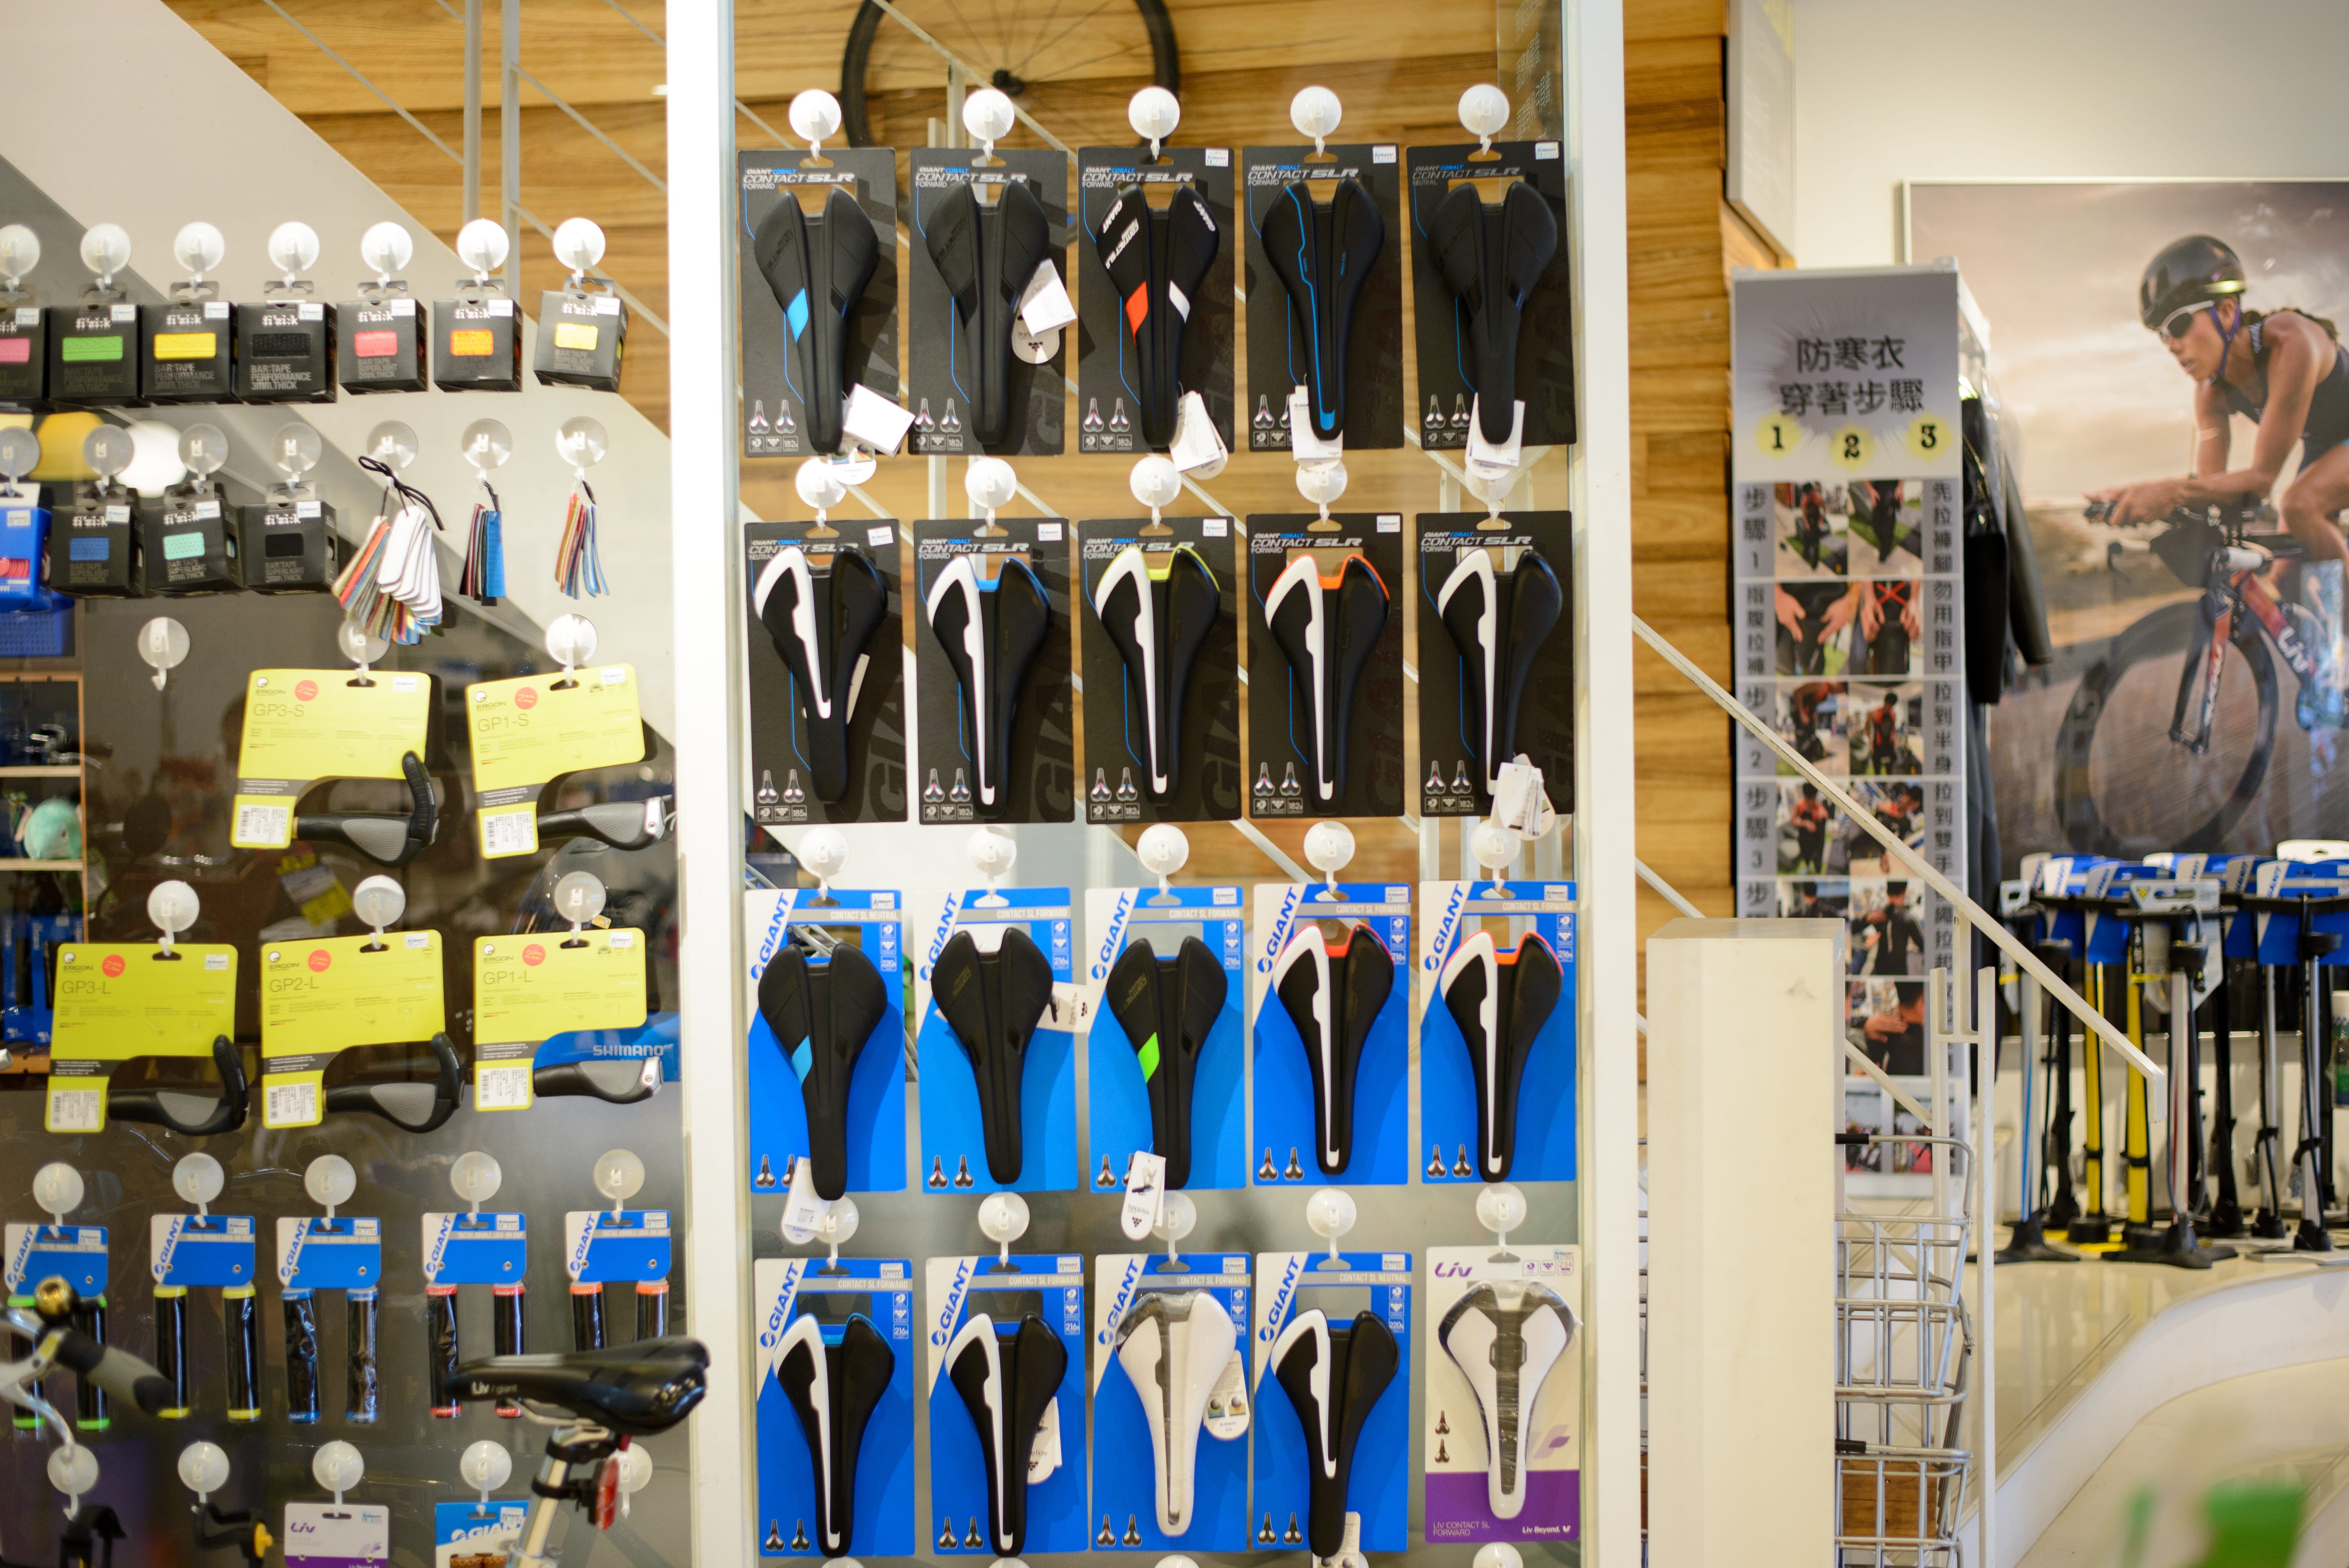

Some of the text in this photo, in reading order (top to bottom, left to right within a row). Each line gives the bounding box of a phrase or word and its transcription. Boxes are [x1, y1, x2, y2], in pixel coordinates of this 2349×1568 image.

[743, 174, 855, 183] CONTACT SLR
[916, 173, 978, 182] CONTACT
[1082, 173, 1193, 182] CONTACT SLR
[1248, 168, 1358, 180] CONTACT SLR
[1413, 167, 1520, 180] CONTACT SLR
[1102, 199, 1122, 233] GIANT
[1193, 200, 1215, 231] GIANT
[1796, 335, 1905, 372] 防寒衣
[251, 372, 312, 381] PERFORMANCE
[1780, 378, 1924, 416] 穿著步驟
[1773, 426, 1784, 449] 1
[1921, 425, 1937, 449] 3
[1844, 435, 1860, 459] 2
[919, 543, 1029, 553] CONTACT SLR
[1251, 538, 1362, 547] CONTACT SLR
[1421, 536, 1532, 546] CONTACT SLR
[2278, 626, 2310, 673] Liv
[254, 704, 305, 717] GP3-S
[478, 714, 529, 731] GP1-S
[997, 908, 1067, 919] CONTACT SL FORWARD
[1169, 909, 1239, 919] CONTACT SL FORWARD
[1336, 905, 1406, 914] CONTACT SL FORWARD
[1502, 902, 1573, 911] CONTACT SL FORWARD
[831, 911, 898, 920] CONTACT SL NEUTRAL
[1267, 887, 1297, 956] GIANT
[1434, 884, 1463, 954] GIANT
[760, 892, 789, 963] GIANT
[929, 893, 957, 963] GIANT
[1101, 892, 1130, 963] GIANT
[270, 976, 319, 992] GP2-L
[484, 970, 533, 985] GP1-L
[62, 981, 111, 994] GP3-L
[593, 1045, 664, 1056] SHIMANO
[160, 1217, 180, 1263] GIANT
[286, 1219, 305, 1266] GIANT
[432, 1215, 451, 1262] GIANT
[576, 1213, 595, 1260] GIANT
[14, 1226, 34, 1272] GIANT
[1435, 1262, 1473, 1277] Liv
[839, 1280, 908, 1288] CONTACT SL FORWARD
[1009, 1275, 1078, 1285] CONTACT SL FORWARD
[1177, 1275, 1246, 1284] CONTACT SL FORWARD
[1340, 1273, 1406, 1282] CONTACT SL NEUTRAL
[769, 1262, 798, 1331] GIANT
[940, 1259, 969, 1329] GIANT
[1108, 1258, 1138, 1327] GIANT
[1269, 1256, 1299, 1325] GIANT
[291, 1523, 315, 1533] Liv
[1535, 1526, 1560, 1534] Beyond.
